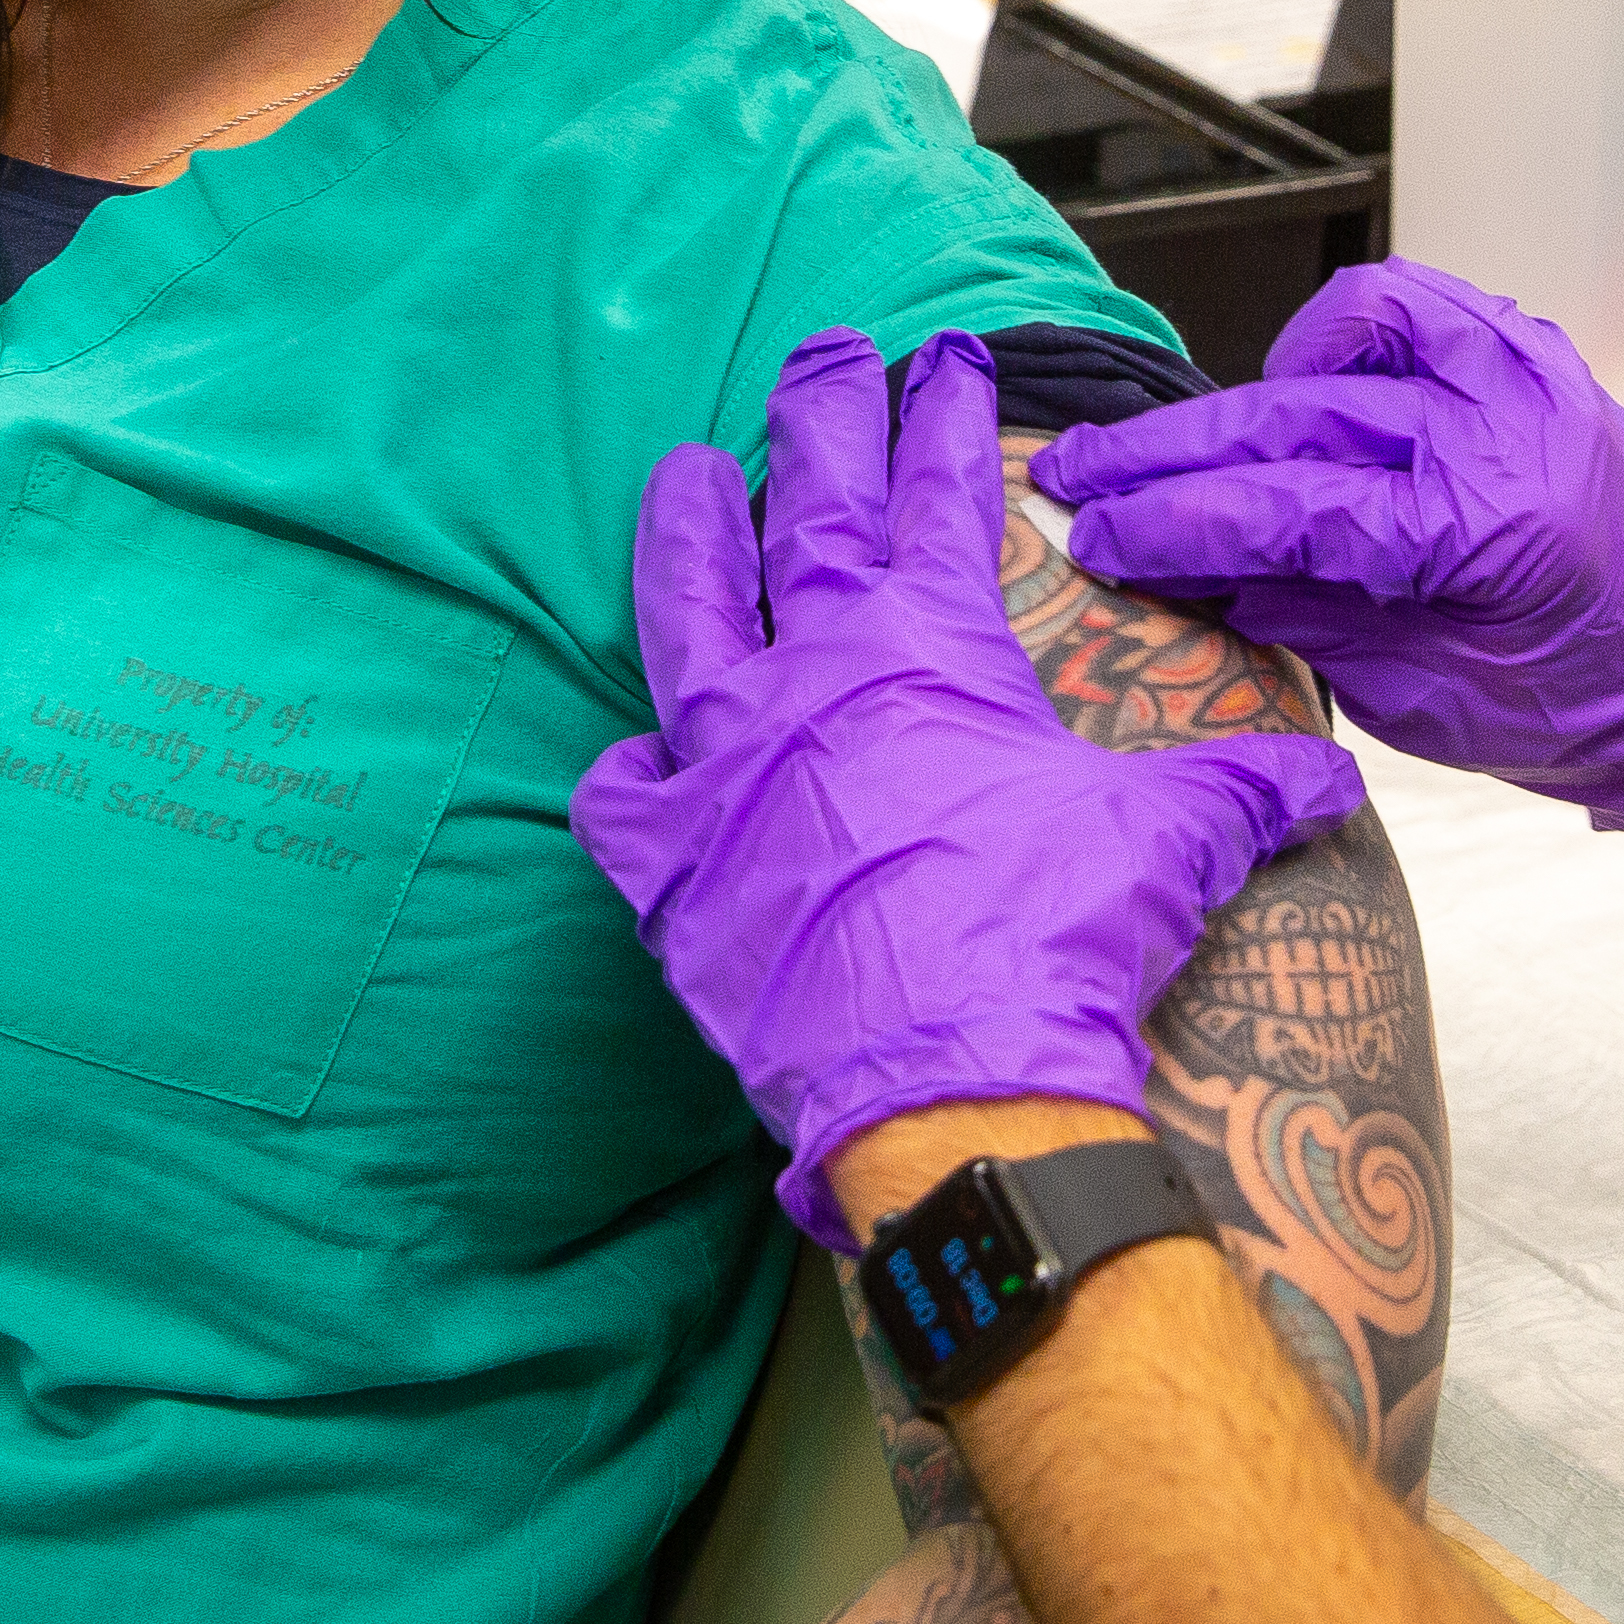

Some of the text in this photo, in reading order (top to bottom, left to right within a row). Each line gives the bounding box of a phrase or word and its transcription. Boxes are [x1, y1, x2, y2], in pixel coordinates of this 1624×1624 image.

[116, 656, 319, 748] Property of:
[31, 693, 368, 812] University Hospital
[102, 781, 247, 844] Sciences
[253, 824, 367, 876] Center
